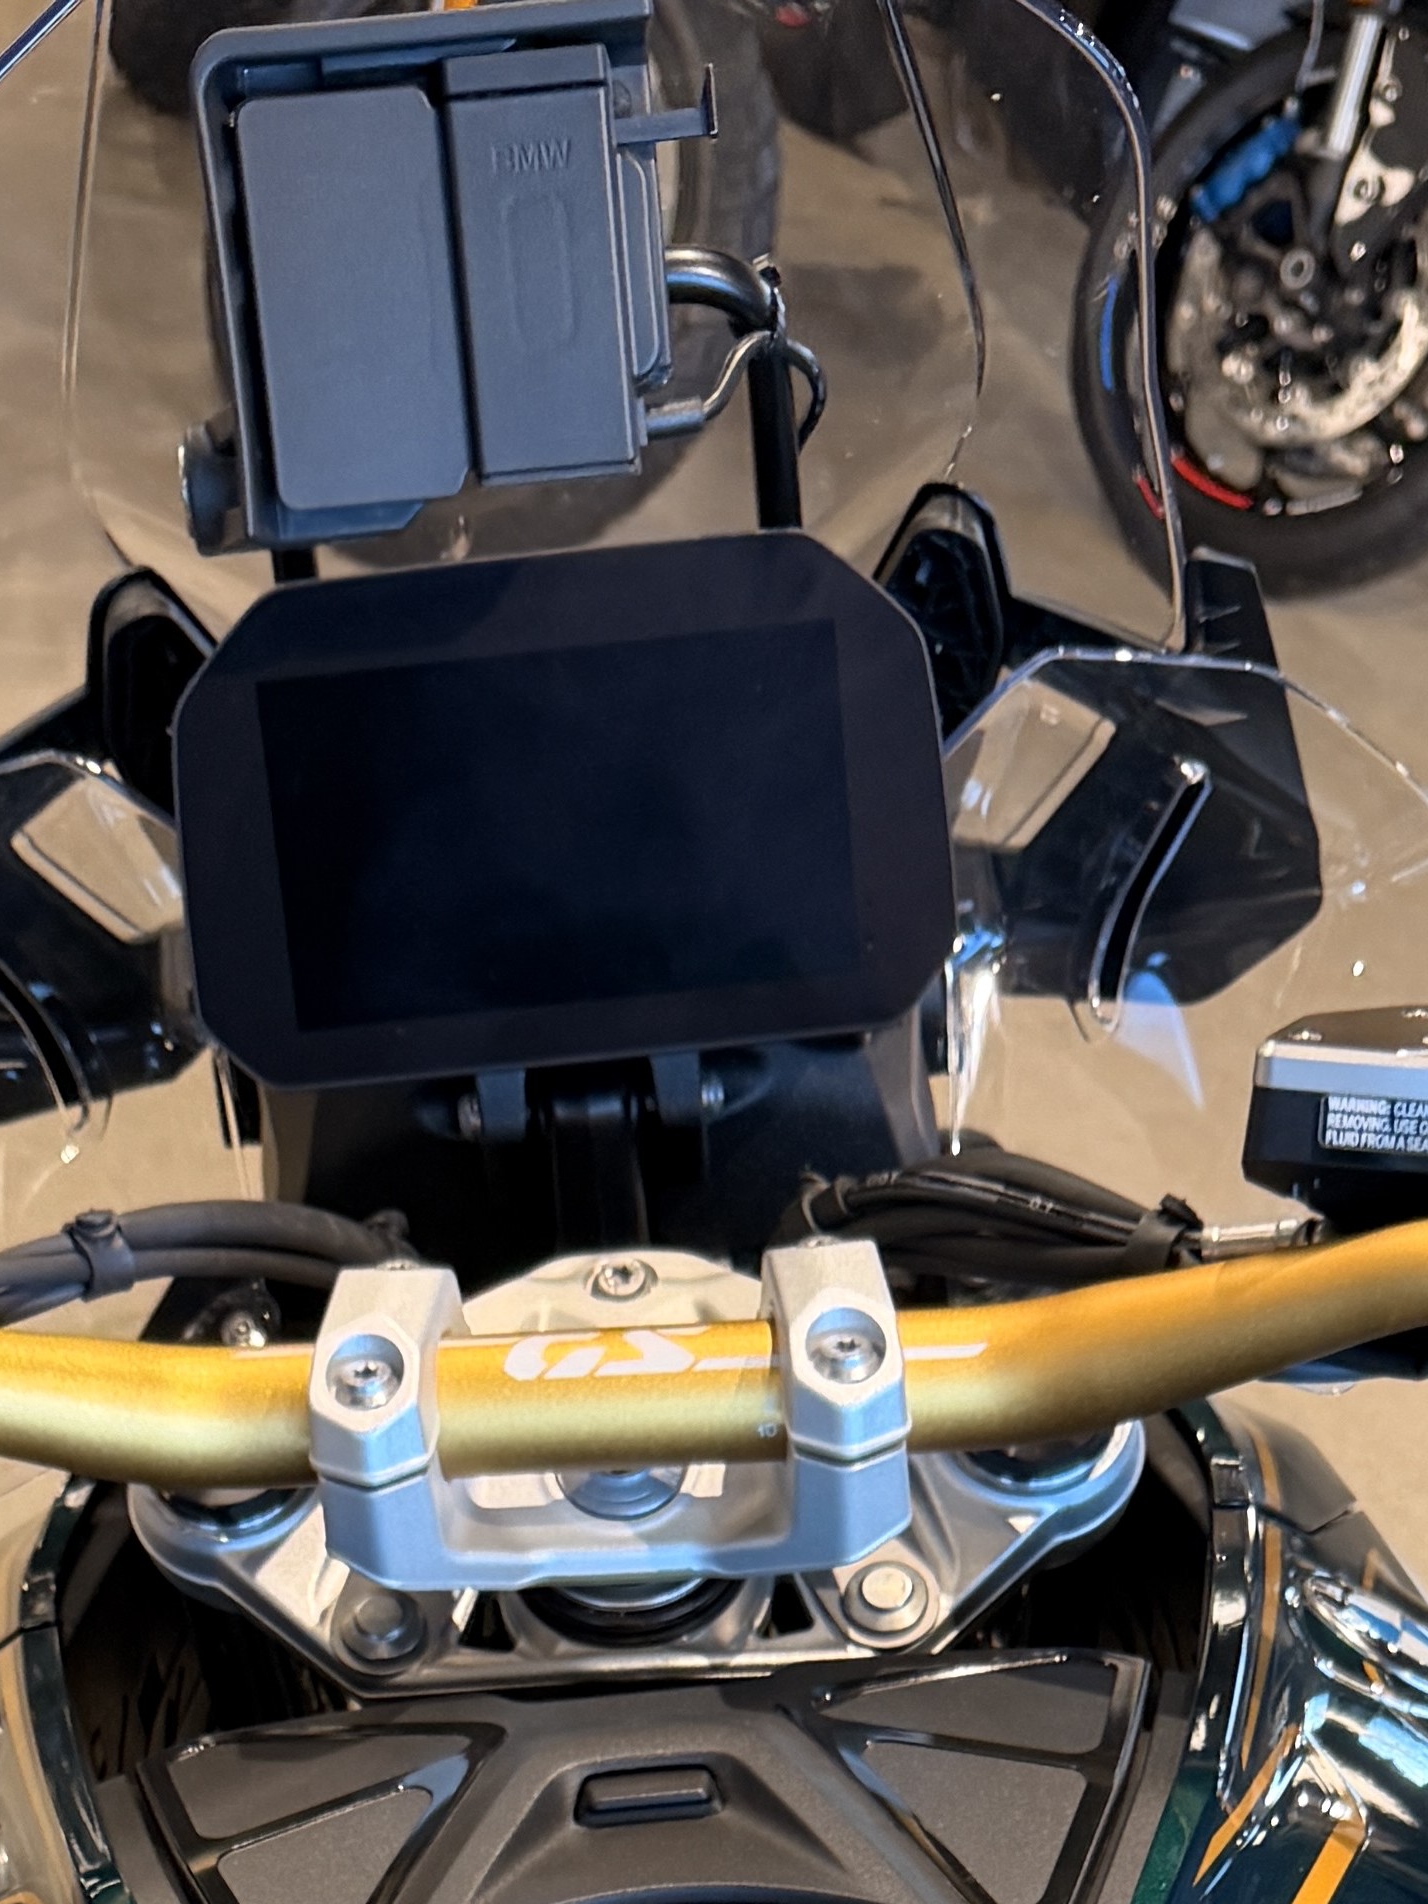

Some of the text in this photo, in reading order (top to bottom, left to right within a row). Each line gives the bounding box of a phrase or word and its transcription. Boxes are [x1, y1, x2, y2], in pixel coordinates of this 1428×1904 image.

[1327, 1097, 1391, 1115] WARNING:
[1393, 1119, 1418, 1135] USE
[1325, 1130, 1359, 1147] FLUID
[1359, 1132, 1395, 1150] FROM
[503, 1327, 697, 1382] GS
